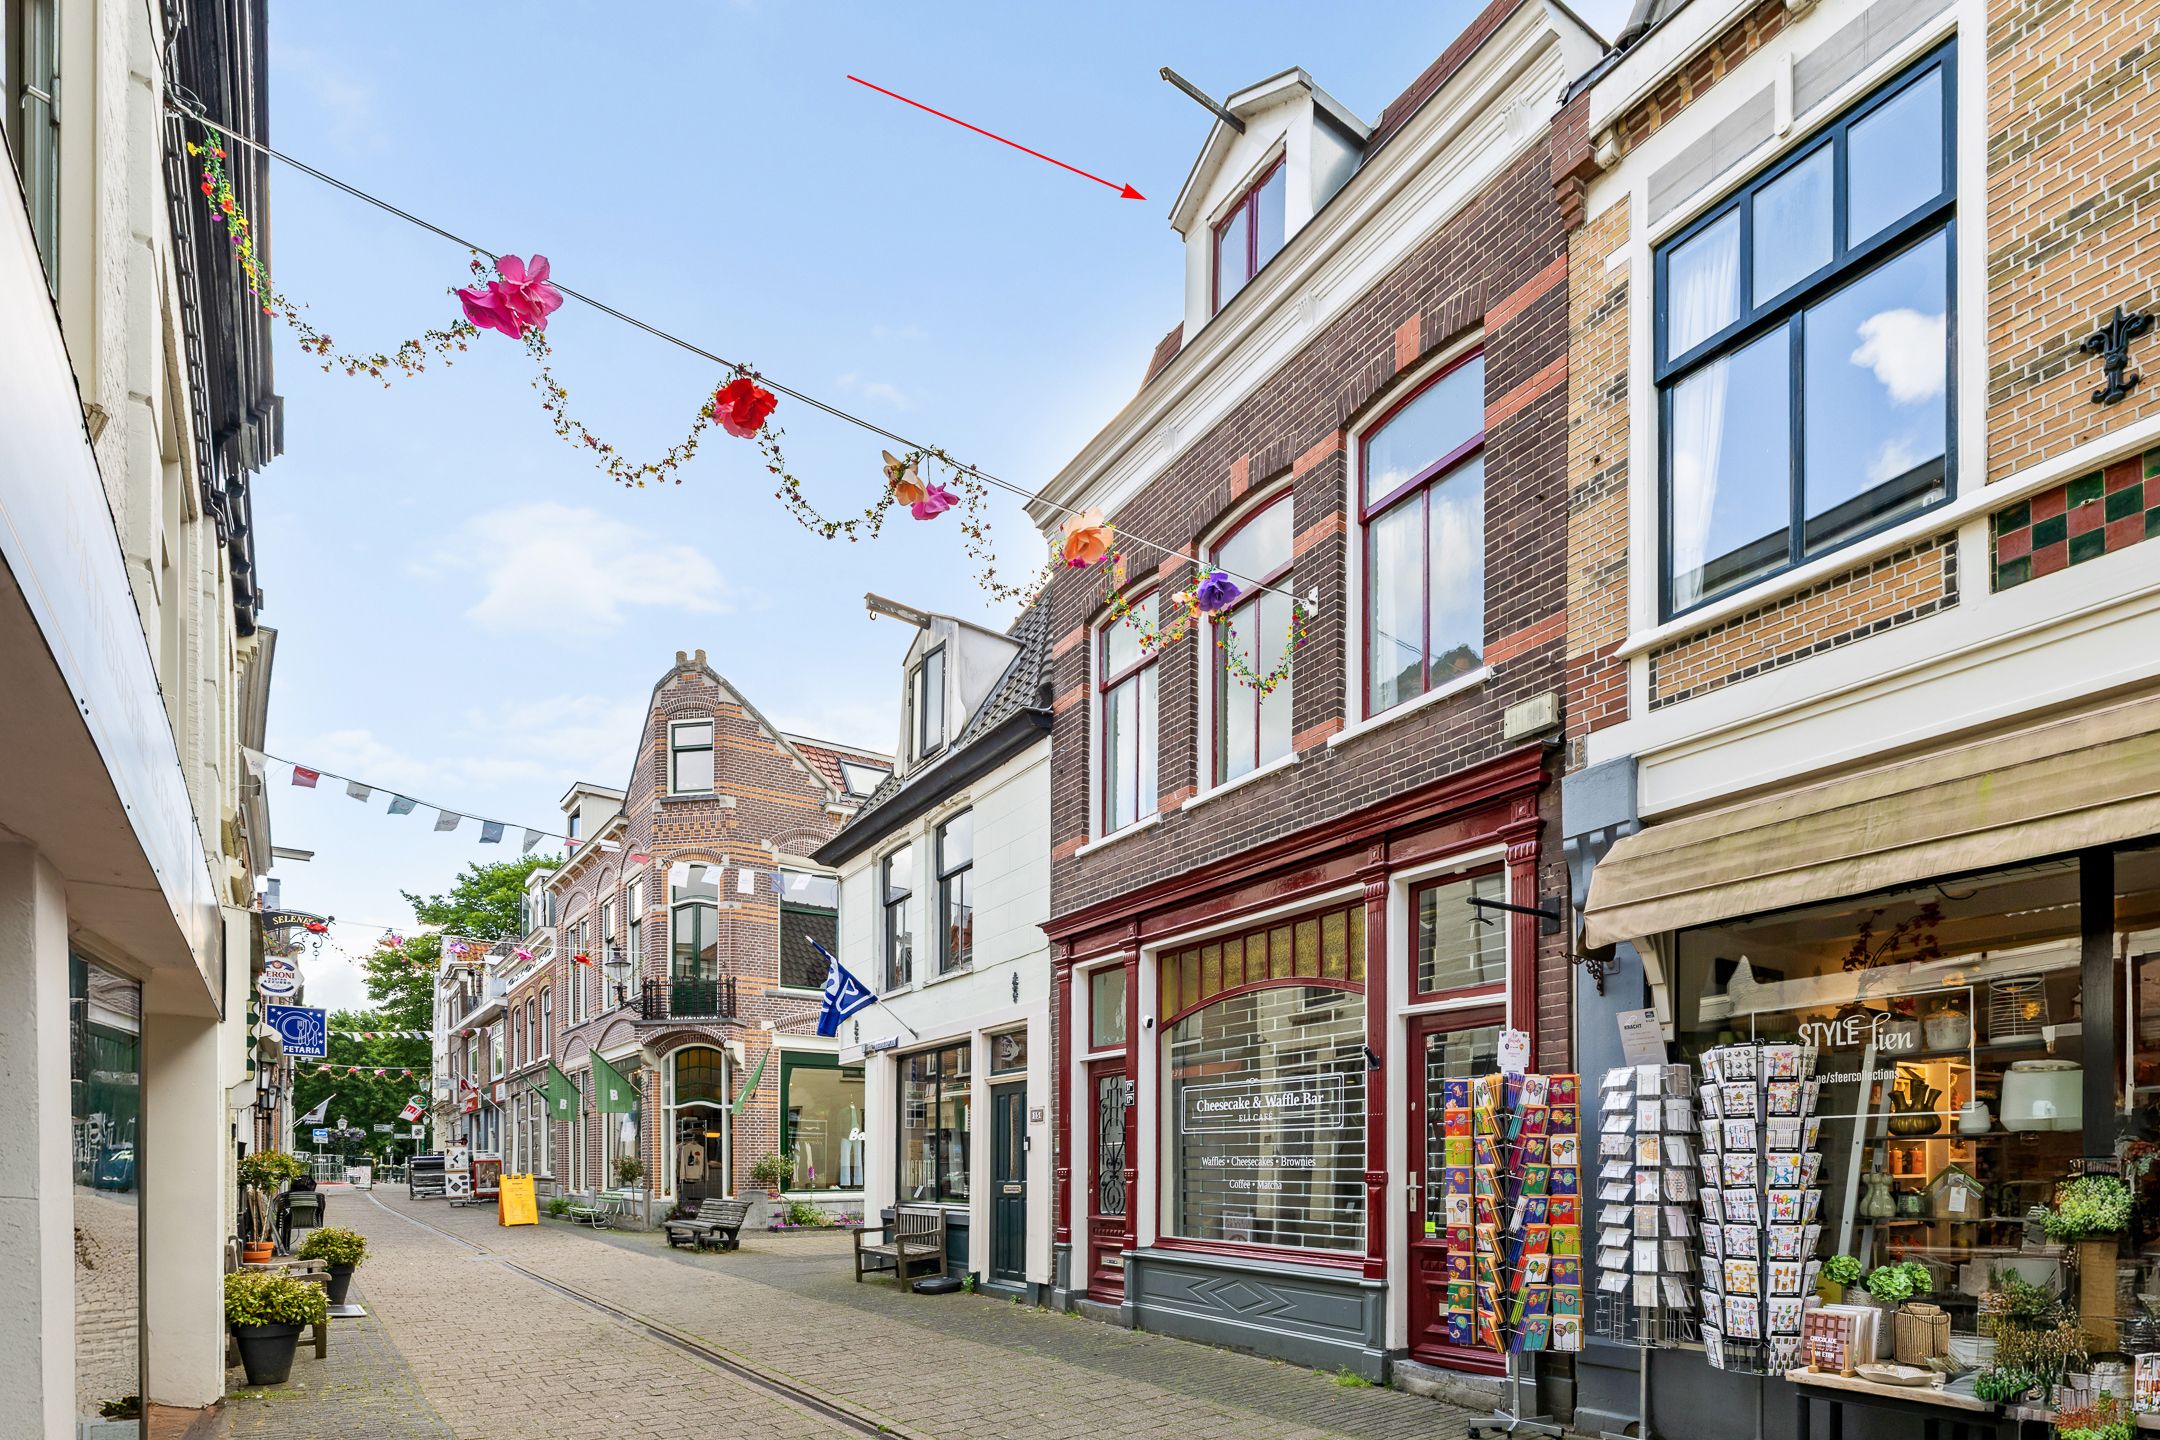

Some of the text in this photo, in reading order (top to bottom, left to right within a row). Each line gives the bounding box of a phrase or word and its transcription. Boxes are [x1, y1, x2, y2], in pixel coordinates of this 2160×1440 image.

[257, 968, 295, 980] ERONI
[1798, 1018, 1860, 1047] STYLE
[609, 1089, 619, 1101] B
[559, 1098, 568, 1110] B
[1196, 1092, 1324, 1112] Cheesecake & Waffle Bar
[1201, 1157, 1317, 1167] Waffles Cheesecakes Brownies
[1229, 1179, 1283, 1190] Coffee Matcha
